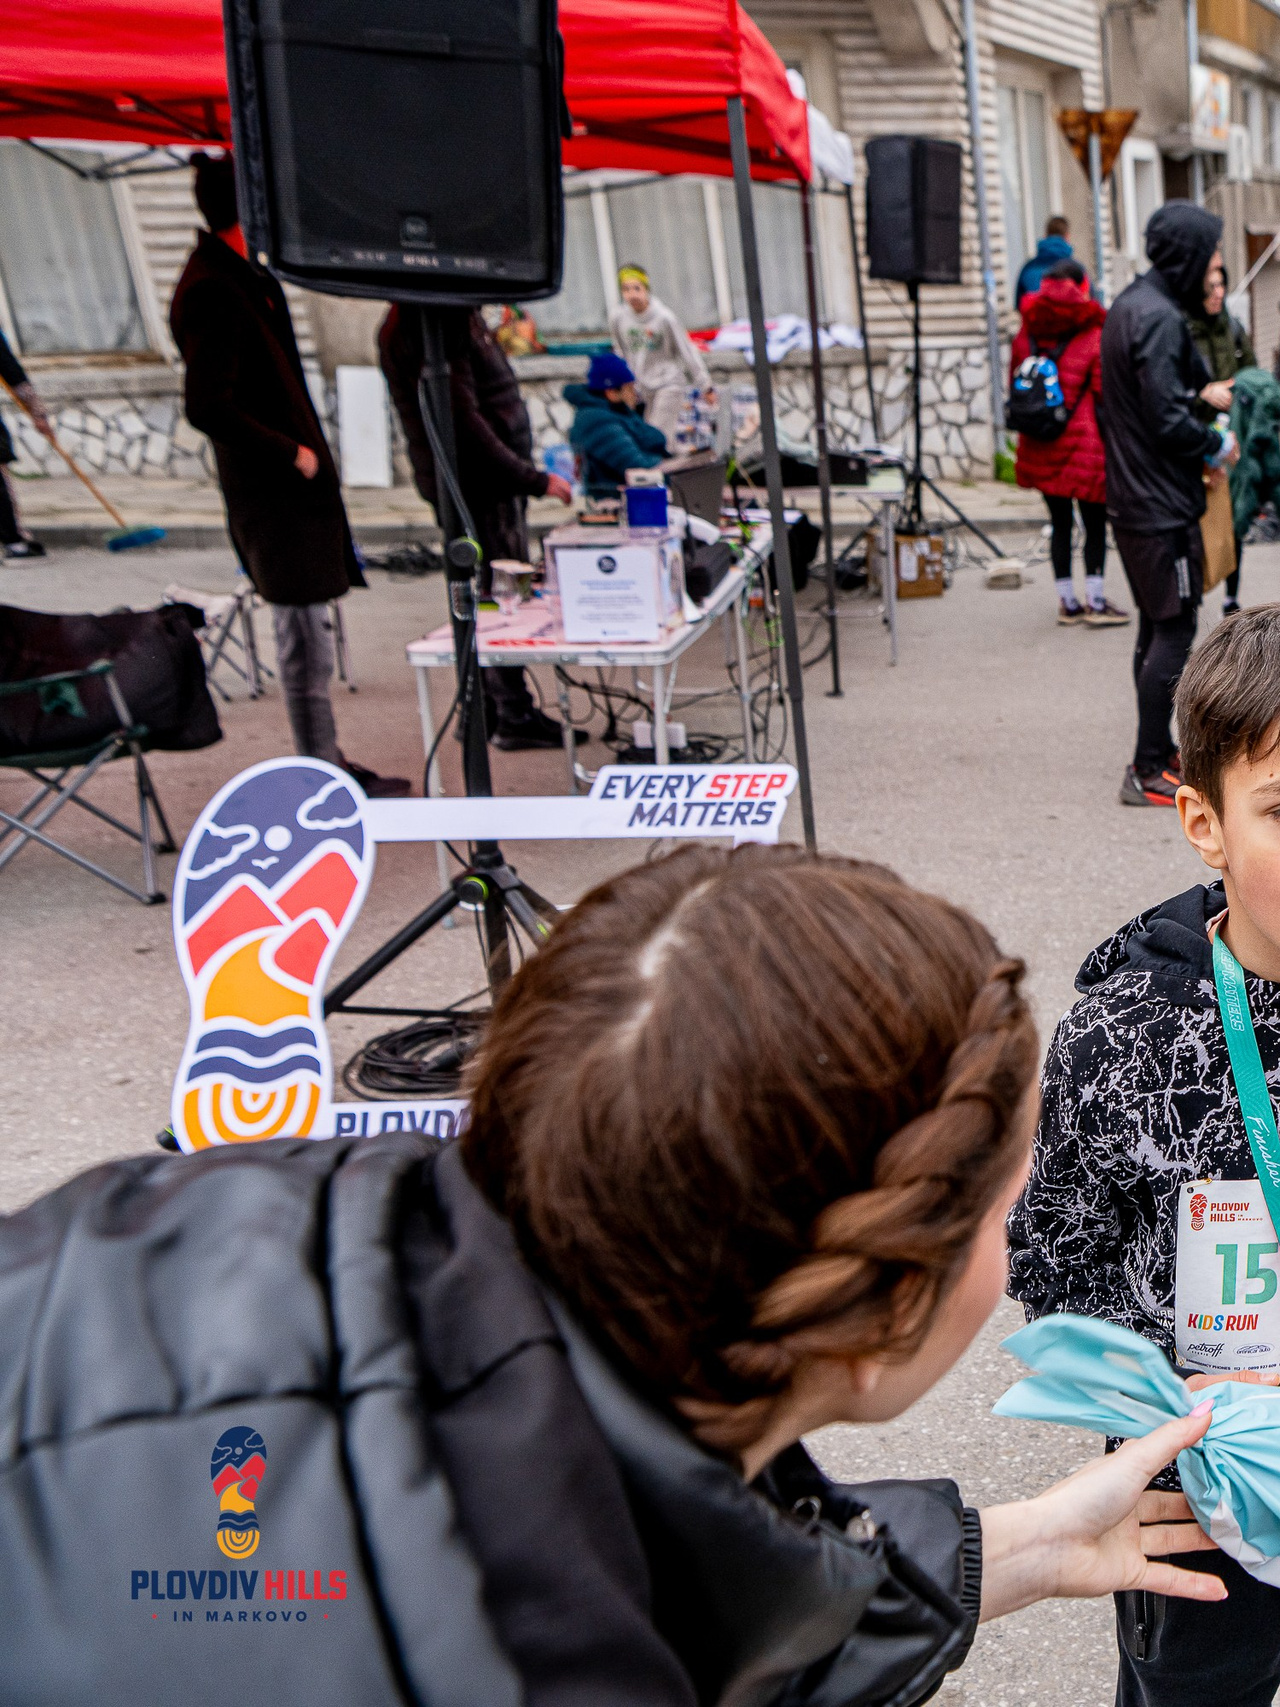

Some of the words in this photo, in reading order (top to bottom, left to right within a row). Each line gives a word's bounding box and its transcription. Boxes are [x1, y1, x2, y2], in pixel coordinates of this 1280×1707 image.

[600, 774, 706, 799] EVERY
[705, 773, 788, 798] STEP
[627, 801, 777, 827] MATTERS
[1222, 971, 1245, 1032] MATTERS
[1210, 1202, 1250, 1212] PLOVDIV
[1210, 1213, 1236, 1222] HILLS
[1187, 1313, 1224, 1332] KIDS
[1225, 1313, 1259, 1332] RUN
